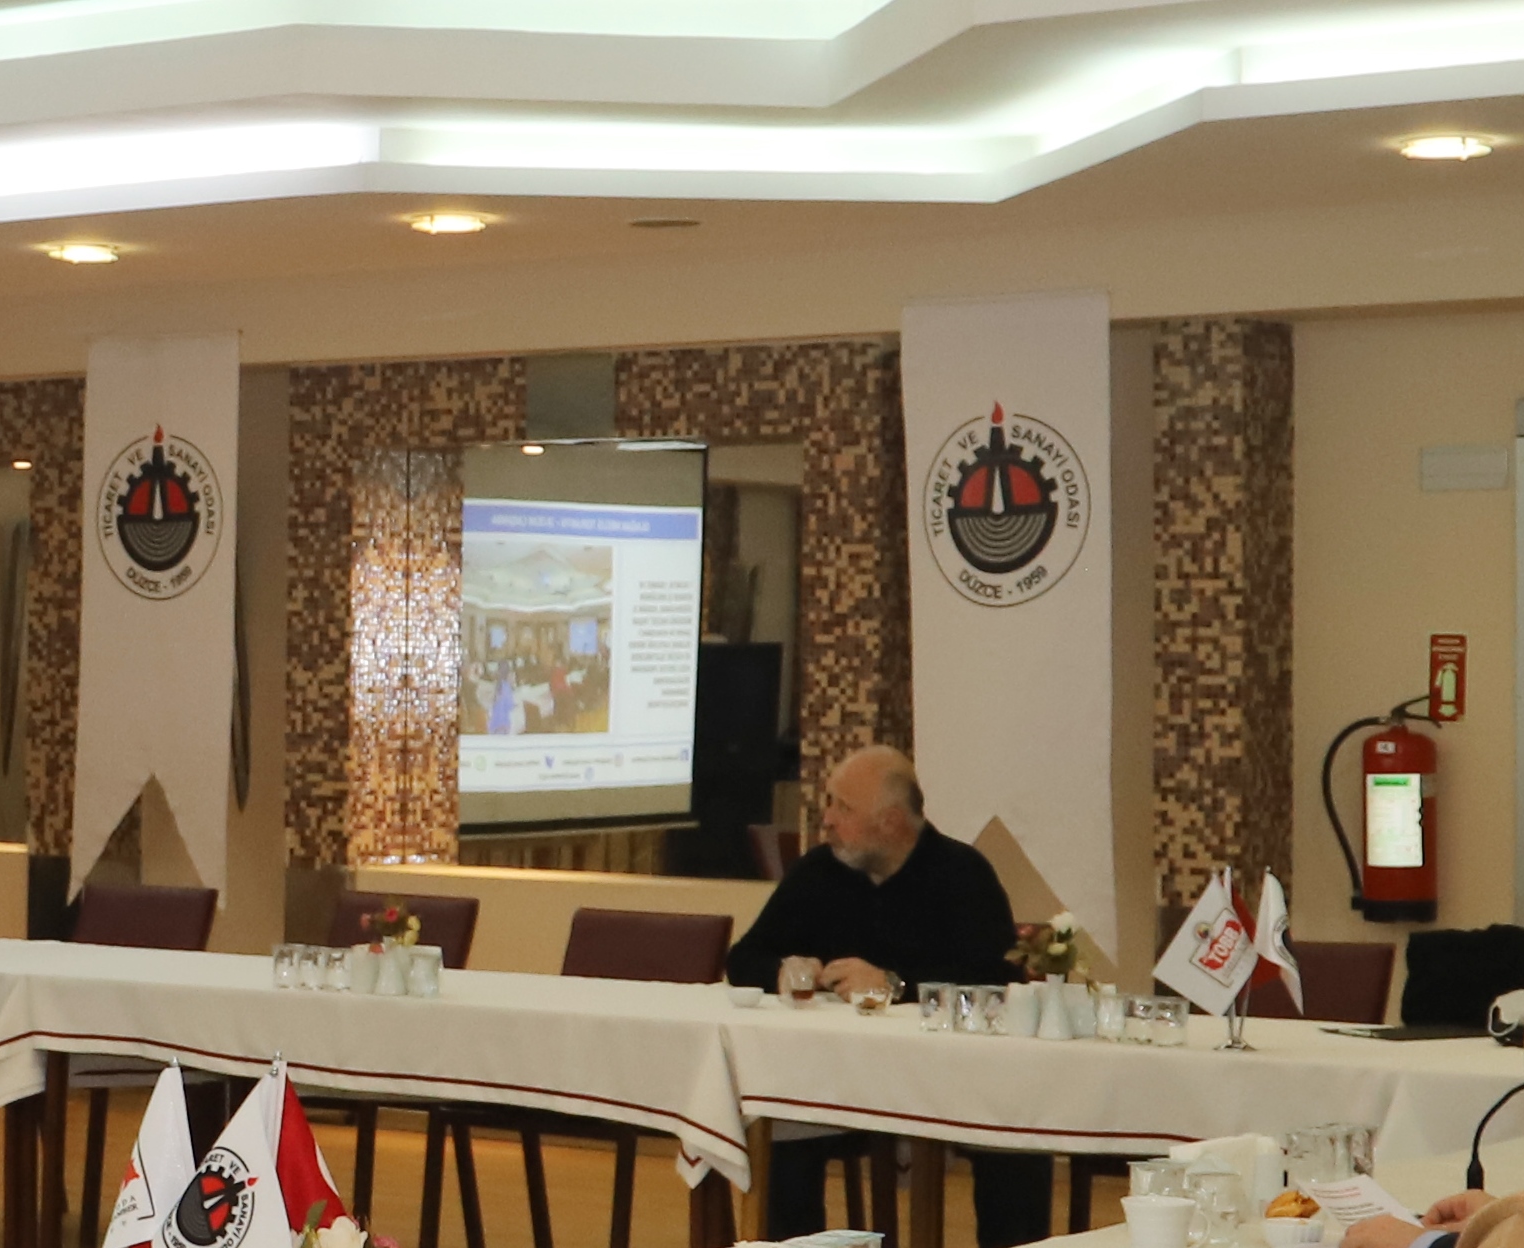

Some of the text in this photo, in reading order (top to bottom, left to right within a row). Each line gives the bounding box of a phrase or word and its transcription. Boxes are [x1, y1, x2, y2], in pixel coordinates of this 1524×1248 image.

[127, 448, 144, 465] VE
[932, 424, 1081, 537] TİCARET VE SANAYİ ODASI
[957, 569, 1003, 599] DÜZCE
[1016, 565, 1048, 594] 1959
[1207, 927, 1239, 962] TOBB
[229, 1160, 242, 1174] VE
[233, 1194, 249, 1239] SANAYİ
